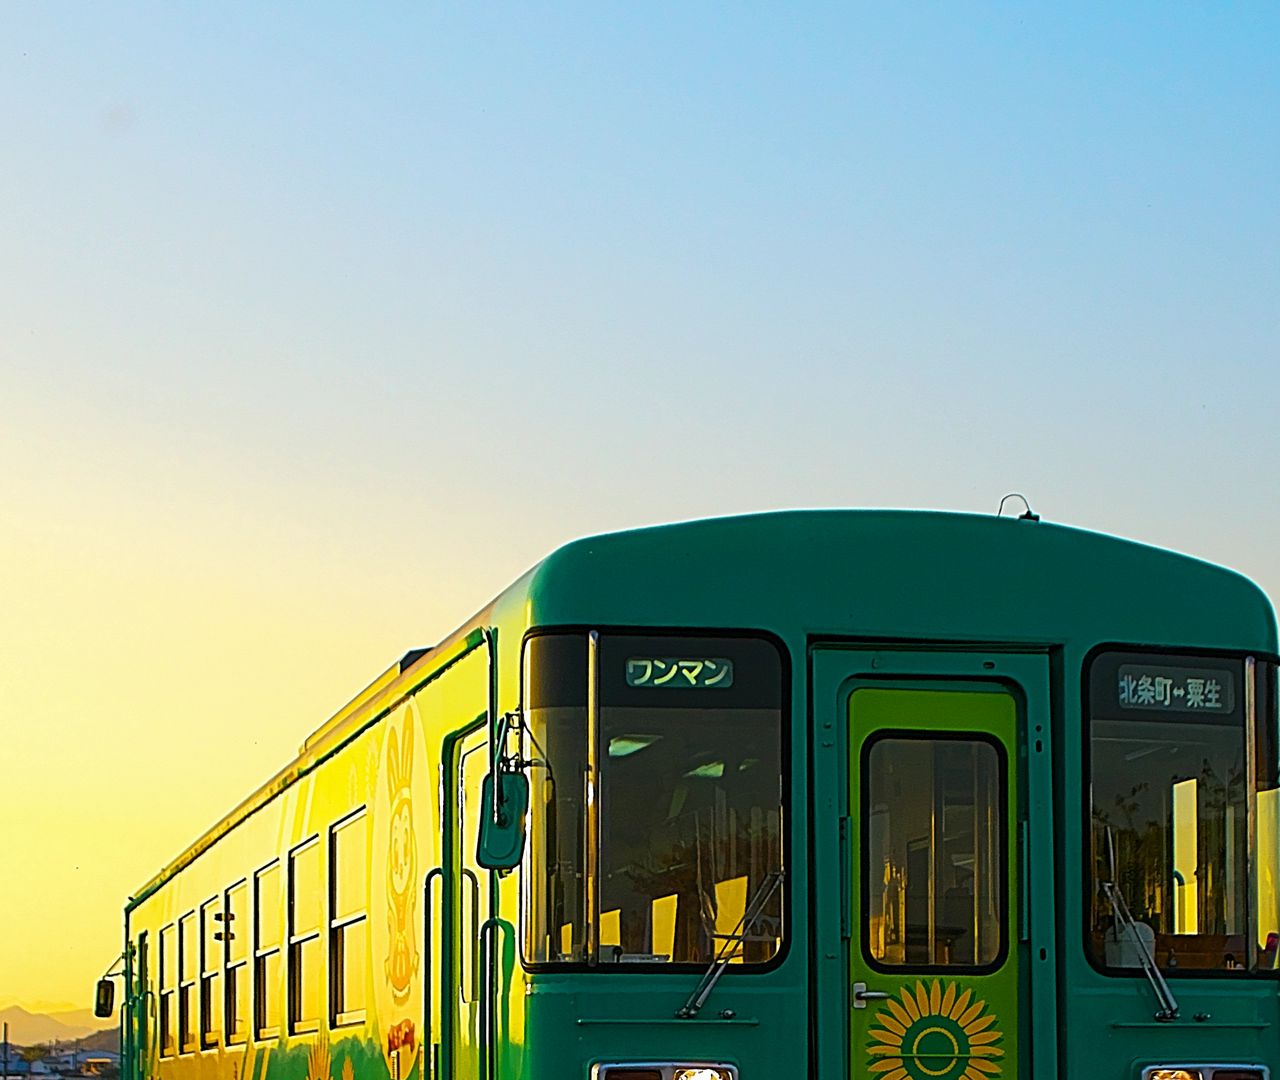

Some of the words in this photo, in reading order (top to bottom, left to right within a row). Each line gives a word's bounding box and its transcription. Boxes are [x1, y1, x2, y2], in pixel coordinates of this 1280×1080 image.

[628, 660, 729, 685] ワンマン
[1120, 674, 1173, 706] 北条町
